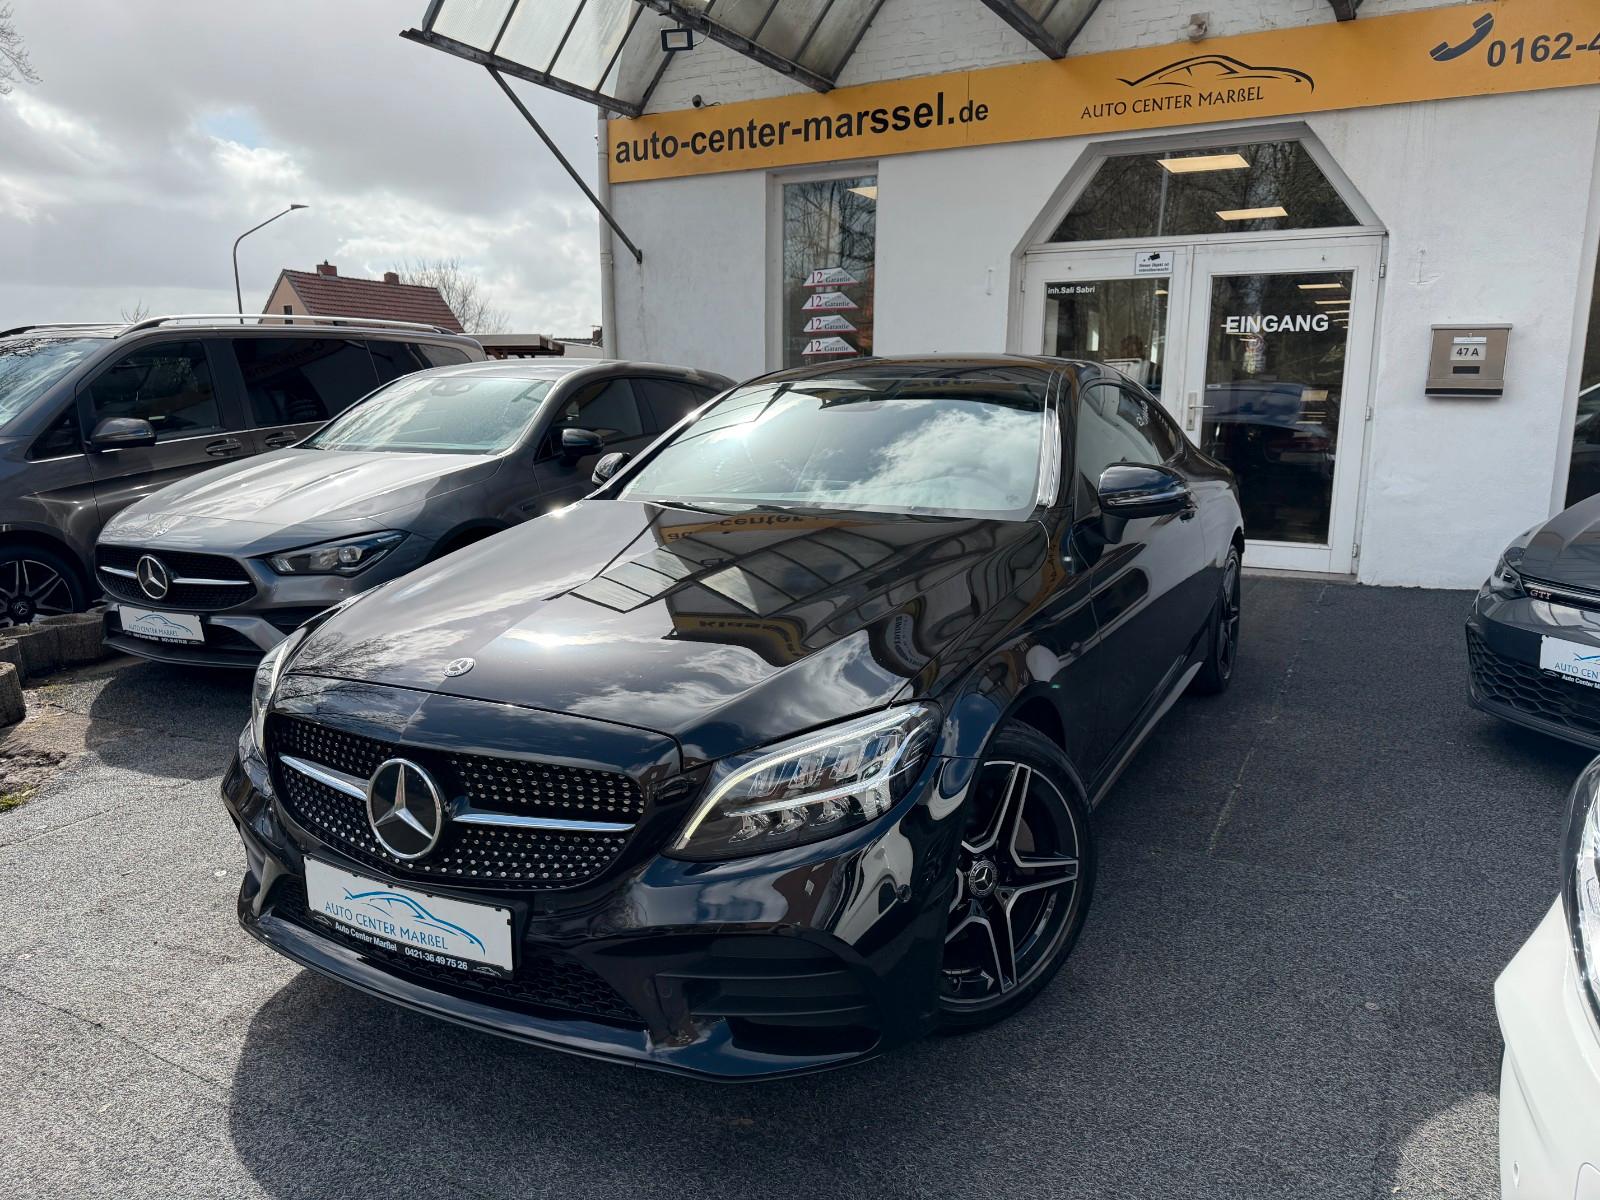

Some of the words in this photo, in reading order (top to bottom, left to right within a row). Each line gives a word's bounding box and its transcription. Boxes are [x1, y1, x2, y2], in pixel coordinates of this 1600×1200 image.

[1080, 101, 1127, 119] AUTO
[1132, 94, 1192, 113] CENTER
[614, 92, 989, 164] auto-center-marssel.de
[811, 271, 822, 283] 12
[811, 296, 822, 308] 12
[811, 318, 822, 330] 12
[1225, 314, 1329, 333] EINGANG
[810, 340, 821, 352] 12
[1456, 347, 1469, 357] 47
[1529, 588, 1552, 600] GTI
[1554, 661, 1579, 674] AUTO
[325, 900, 353, 921] AUTO
[355, 913, 397, 937] CENTER
[335, 921, 350, 935] Auto
[350, 927, 373, 943] Center
